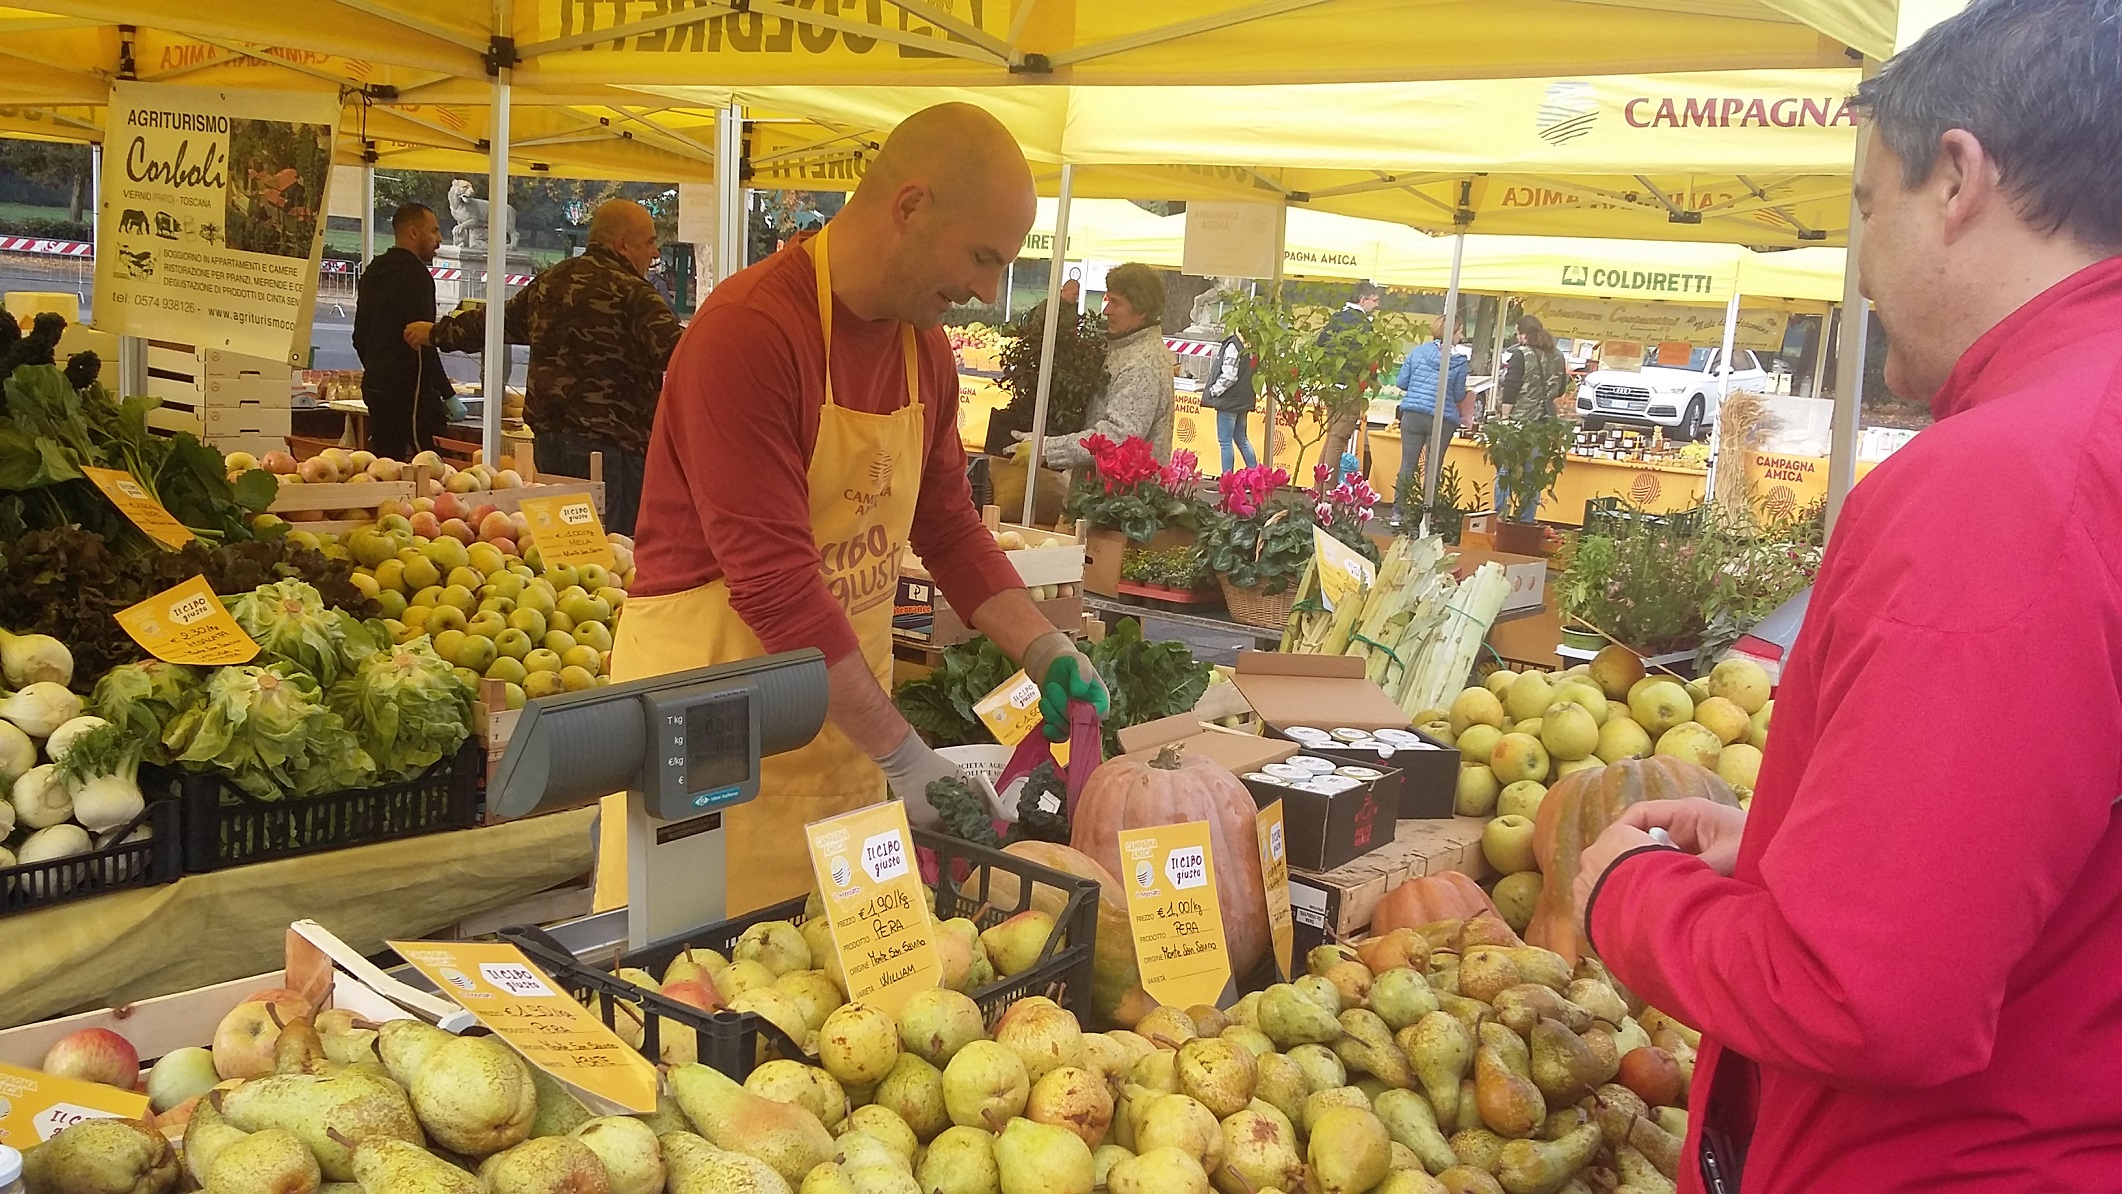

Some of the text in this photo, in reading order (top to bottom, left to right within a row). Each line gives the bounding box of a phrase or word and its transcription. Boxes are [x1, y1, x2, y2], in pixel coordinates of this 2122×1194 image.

[1624, 97, 1858, 128] CAMPAGNA
[127, 109, 228, 134] AGRITURISMO
[126, 135, 226, 188] Corboli
[180, 196, 212, 208] TOSCANA
[163, 249, 298, 277] SOGGIORNO IN APPARTAMENTI E CAMERE
[1321, 254, 1357, 267] AMICA
[163, 263, 210, 278] RISTORAZIONE
[211, 269, 225, 281] PER
[253, 277, 287, 291] MERENDE
[288, 281, 295, 291] E
[1592, 268, 1713, 294] COLDIRETTI
[163, 277, 213, 293] DEGUSTAZIONE
[214, 285, 222, 295] DI
[222, 286, 257, 301] PRODOTTI
[257, 292, 265, 301] DI
[266, 293, 286, 305] CINTA
[112, 291, 131, 304] tel:
[134, 295, 160, 308] 0574
[162, 298, 195, 314] 938126
[1756, 456, 1815, 473] CAMPAGNA
[1764, 468, 1803, 483] AMICA
[674, 715, 683, 725] kg
[674, 736, 684, 746] kg
[678, 775, 684, 785] €
[876, 840, 901, 857] CIBO
[874, 855, 901, 878] giusto
[1180, 855, 1203, 867] CIBO
[1176, 871, 1201, 885] giusto
[837, 916, 856, 928] PREZZO
[1136, 914, 1154, 922] PREZZO
[843, 919, 904, 952] PRODOTTO PERA
[1140, 921, 1199, 943] PRODOTTO PERA
[849, 961, 870, 975] ORIGINE
[1144, 955, 1163, 964] ORIGINE
[499, 969, 533, 979] CIBO
[879, 964, 916, 987] WILLIAM
